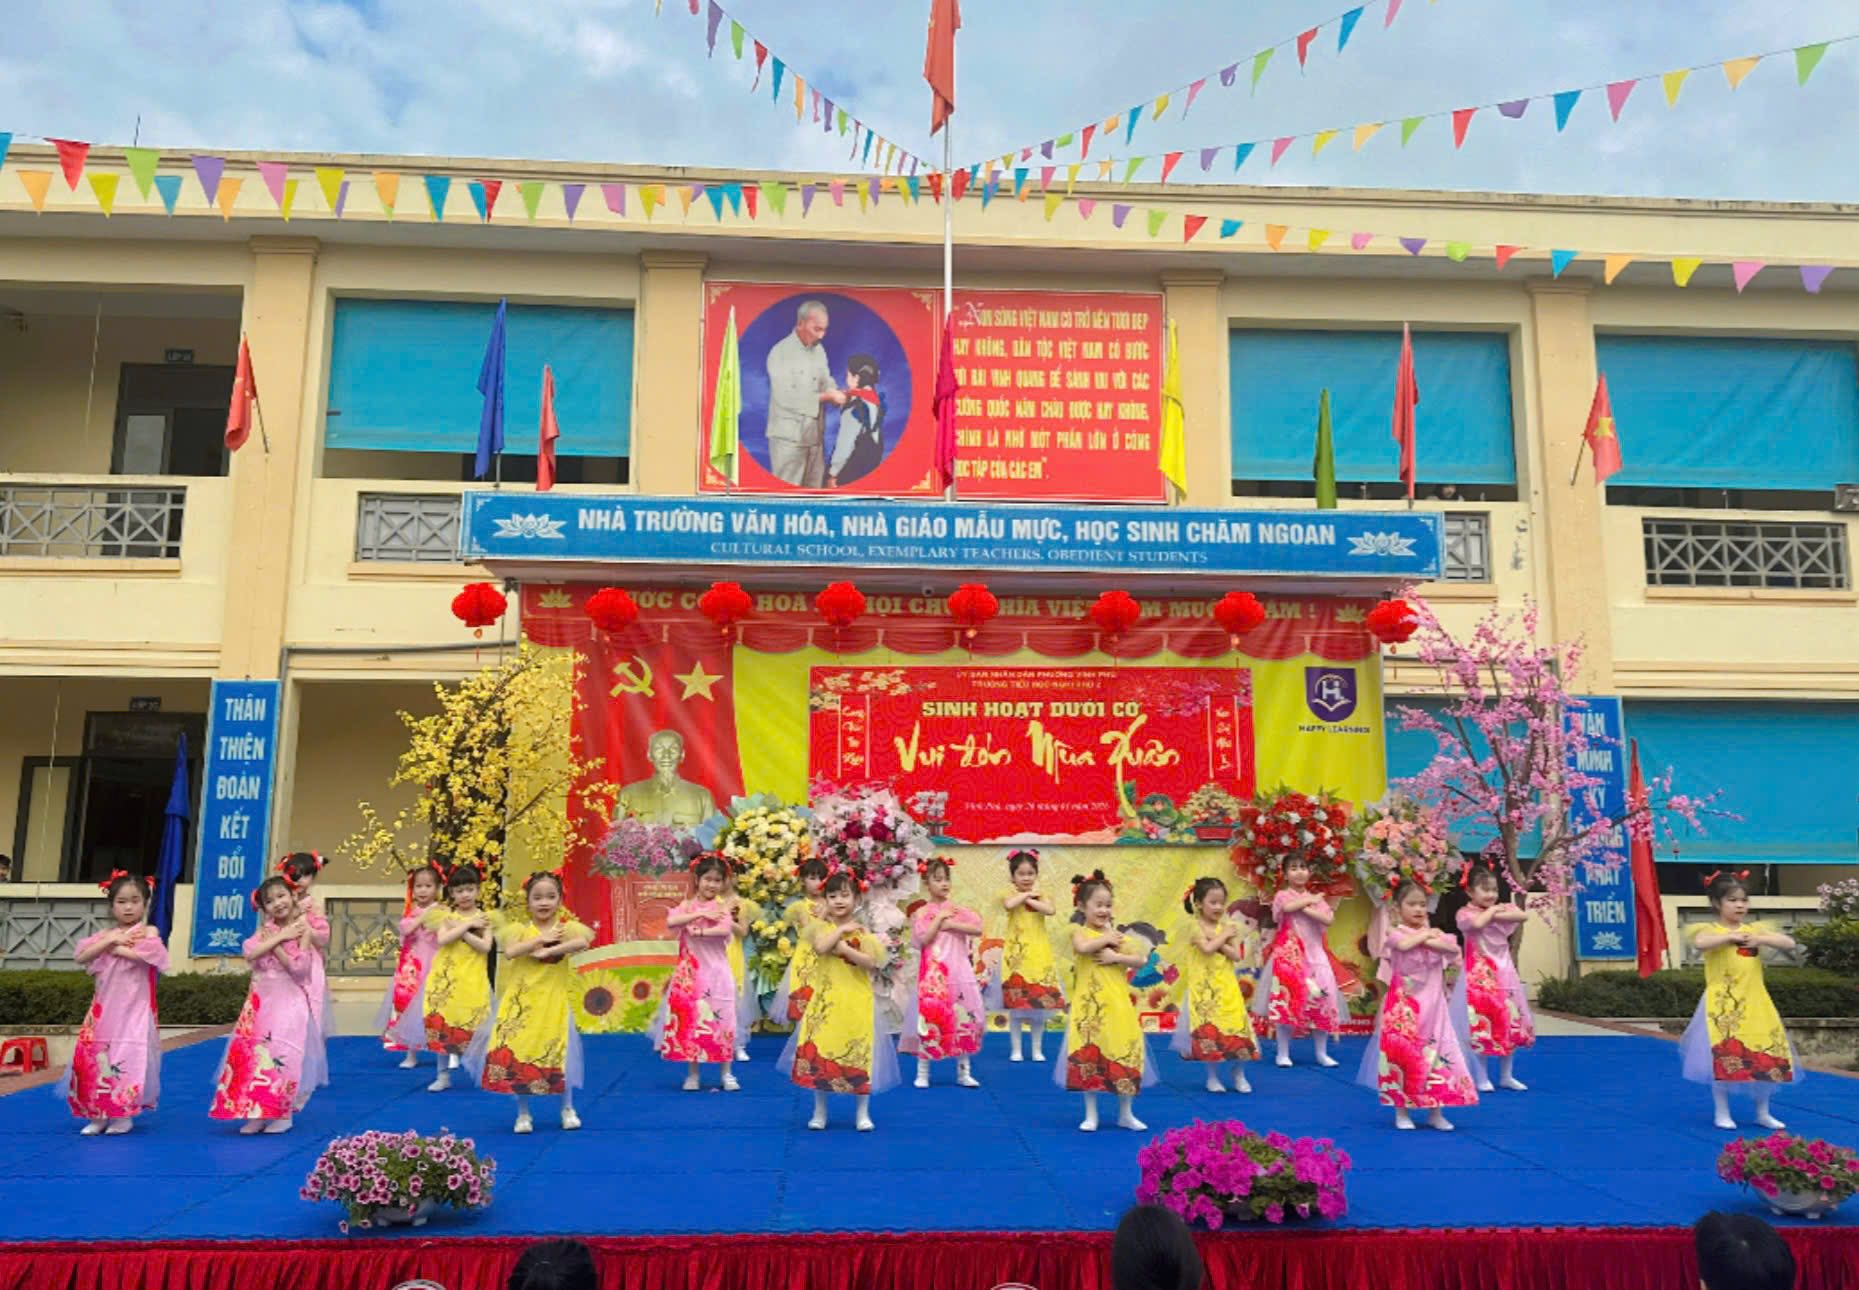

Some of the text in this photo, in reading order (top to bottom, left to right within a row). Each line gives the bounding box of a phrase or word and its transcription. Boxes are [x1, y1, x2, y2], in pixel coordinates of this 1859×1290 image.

[1039, 311, 1058, 328] NAM
[578, 505, 1336, 546] NHÀ TRƯỜNG VĂN HÓA, NHÀ GIÁO MẪU MỰC, HỌC SINH CHĂM NGOAN
[710, 541, 792, 555] CULTURAL
[869, 544, 957, 560] EXEMPLARY
[1047, 549, 1123, 563] OBEDIENT
[1128, 550, 1208, 564] STUDENTS
[225, 693, 266, 721] THÂN
[921, 700, 977, 717] SINH
[983, 700, 1044, 719] HOẠT
[1050, 698, 1105, 717] DƯỚI
[219, 732, 264, 765] THIỆN
[894, 719, 946, 773] Vui
[1100, 714, 1181, 818] Xuân
[216, 771, 260, 800] ĐOÀN
[220, 807, 251, 839] KẾT
[212, 888, 244, 920] MỚI
[1585, 891, 1626, 924] TRIỂN
